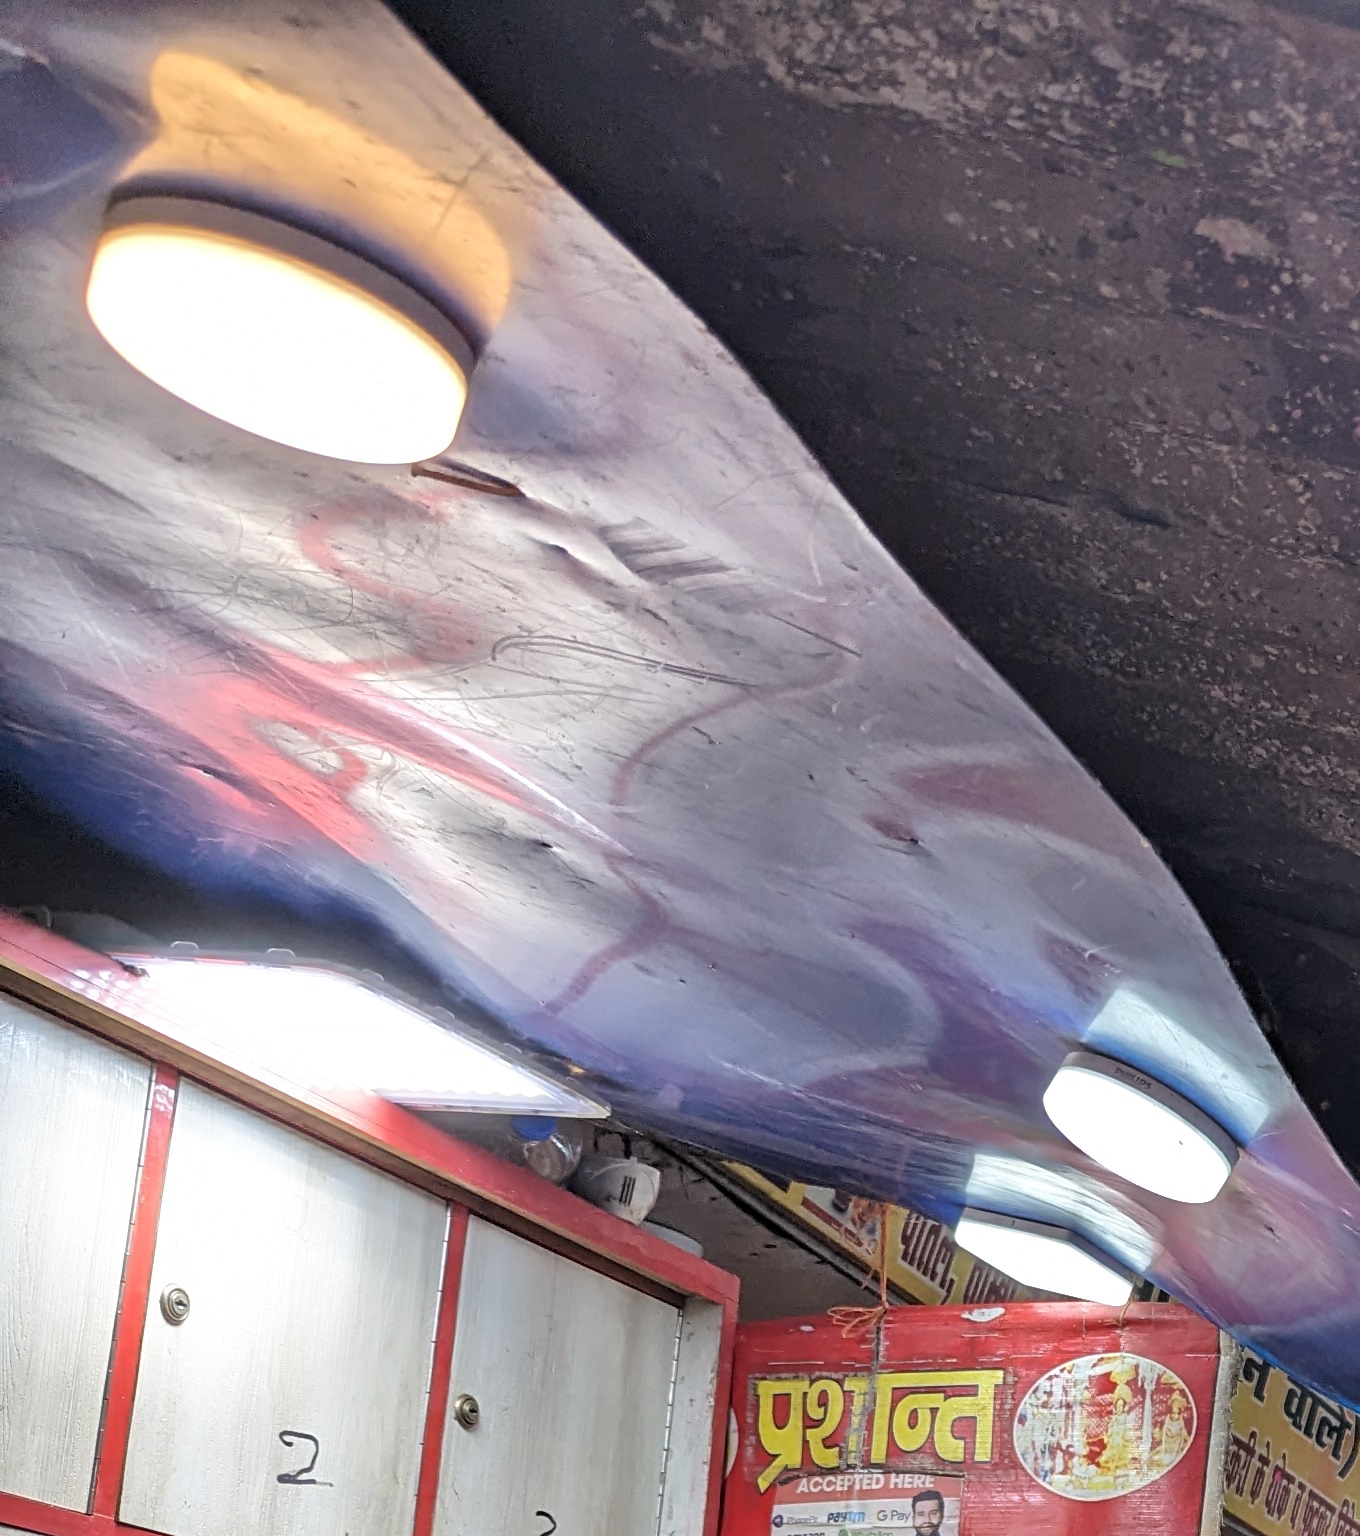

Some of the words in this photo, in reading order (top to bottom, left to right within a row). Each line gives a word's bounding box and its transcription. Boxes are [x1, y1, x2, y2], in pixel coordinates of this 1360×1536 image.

[756, 1370, 1004, 1493] प्रशान्त
[277, 1430, 333, 1488] 2
[797, 1473, 885, 1493] ACCEPTED
[889, 1473, 935, 1489] HERE
[891, 1511, 911, 1523] Pay
